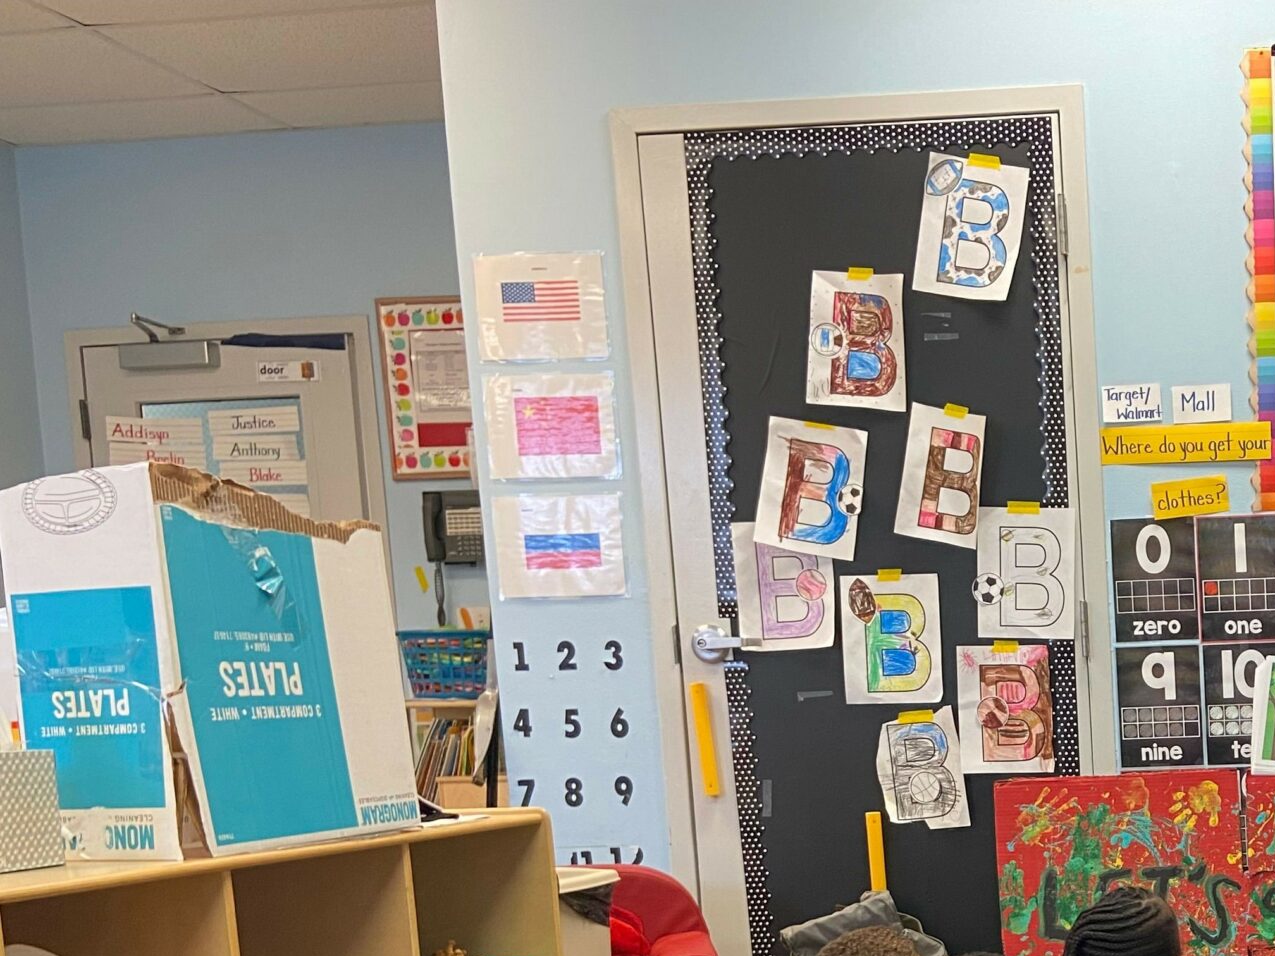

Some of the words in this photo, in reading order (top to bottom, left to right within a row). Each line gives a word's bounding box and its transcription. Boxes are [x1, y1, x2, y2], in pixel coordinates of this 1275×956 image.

[937, 178, 1009, 288] B
[829, 291, 898, 398] B
[259, 364, 286, 375] door
[1104, 387, 1151, 406] Target/
[1181, 391, 1215, 412] Mall
[231, 415, 276, 430] Justice
[1117, 404, 1163, 420] Walmart
[112, 424, 170, 444] Addisyn
[1102, 435, 1153, 455] Where
[1159, 435, 1176, 455] do
[1180, 440, 1203, 460] you
[1208, 432, 1233, 460] get
[1238, 438, 1271, 459] your
[230, 442, 281, 461] Anthony
[250, 468, 283, 483] Blake
[918, 426, 980, 535] B
[779, 436, 851, 545] B
[1157, 483, 1226, 511] clothes?
[1135, 523, 1172, 574] 0
[1234, 522, 1247, 573] 1
[1000, 526, 1065, 627] B
[756, 542, 825, 641] B
[1132, 618, 1182, 636] zero
[1224, 618, 1263, 636] one
[513, 641, 530, 671] 1
[557, 640, 577, 670] 2
[604, 640, 624, 671] 3
[866, 593, 932, 693] B
[219, 660, 304, 698] PLATES
[1141, 651, 1177, 700] 9
[1222, 649, 1267, 699] 10
[52, 688, 131, 718] PLATES
[209, 707, 240, 722] WHITE
[250, 706, 314, 720] COMPARTMENT
[315, 706, 322, 719] 3
[979, 664, 1046, 762] B
[41, 725, 67, 738] WHITE
[76, 723, 138, 736] COMPARTMENT
[141, 722, 146, 735] 3
[513, 708, 532, 738] 4
[564, 708, 581, 739] 5
[610, 707, 629, 738] 6
[1140, 742, 1184, 761] nine
[886, 721, 958, 821] B
[517, 779, 535, 807] 7
[564, 777, 584, 807] 8
[614, 775, 634, 806] 9
[125, 814, 154, 824] CLEANING
[361, 802, 418, 827] MONOGRAM
